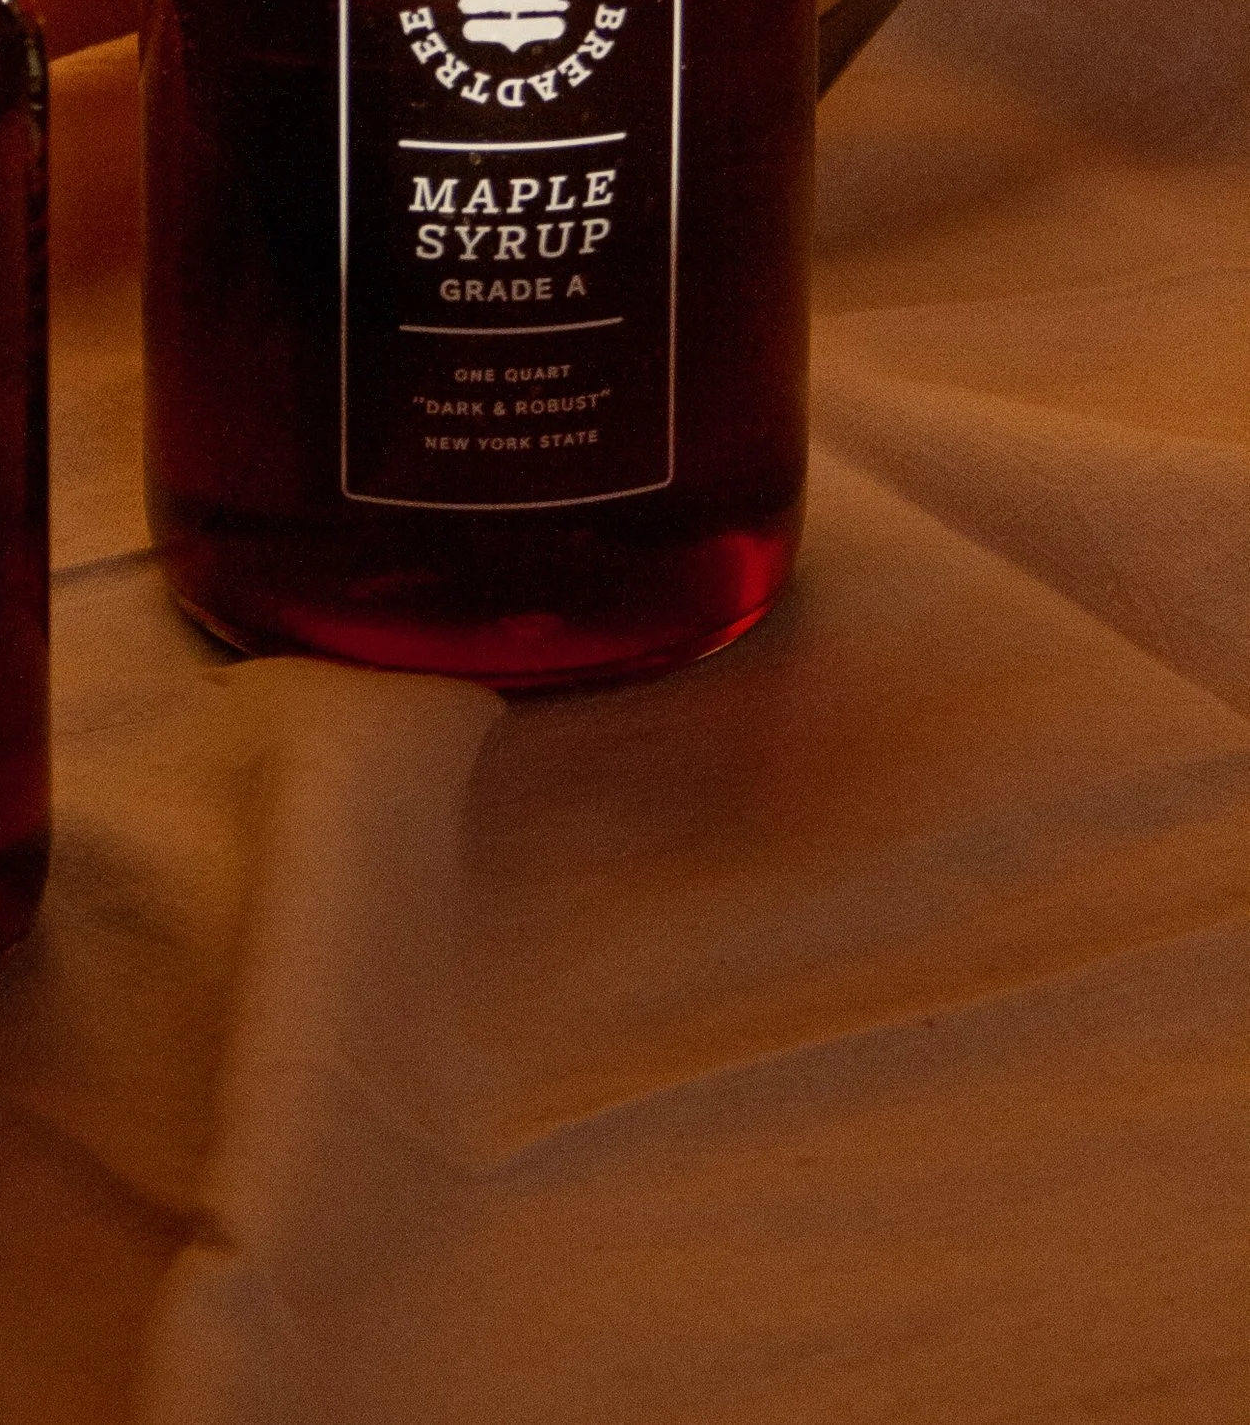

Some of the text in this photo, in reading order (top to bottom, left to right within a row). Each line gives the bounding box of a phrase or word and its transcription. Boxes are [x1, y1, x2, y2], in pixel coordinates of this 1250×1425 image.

[399, 4, 627, 107] BREADTREE
[409, 170, 617, 215] MAPLE
[415, 218, 611, 261] SYRUP
[440, 275, 588, 302] GRADE A
[454, 364, 572, 382] ONE QUART
[493, 400, 507, 416] &
[424, 429, 599, 451] NEW YORK STATE
